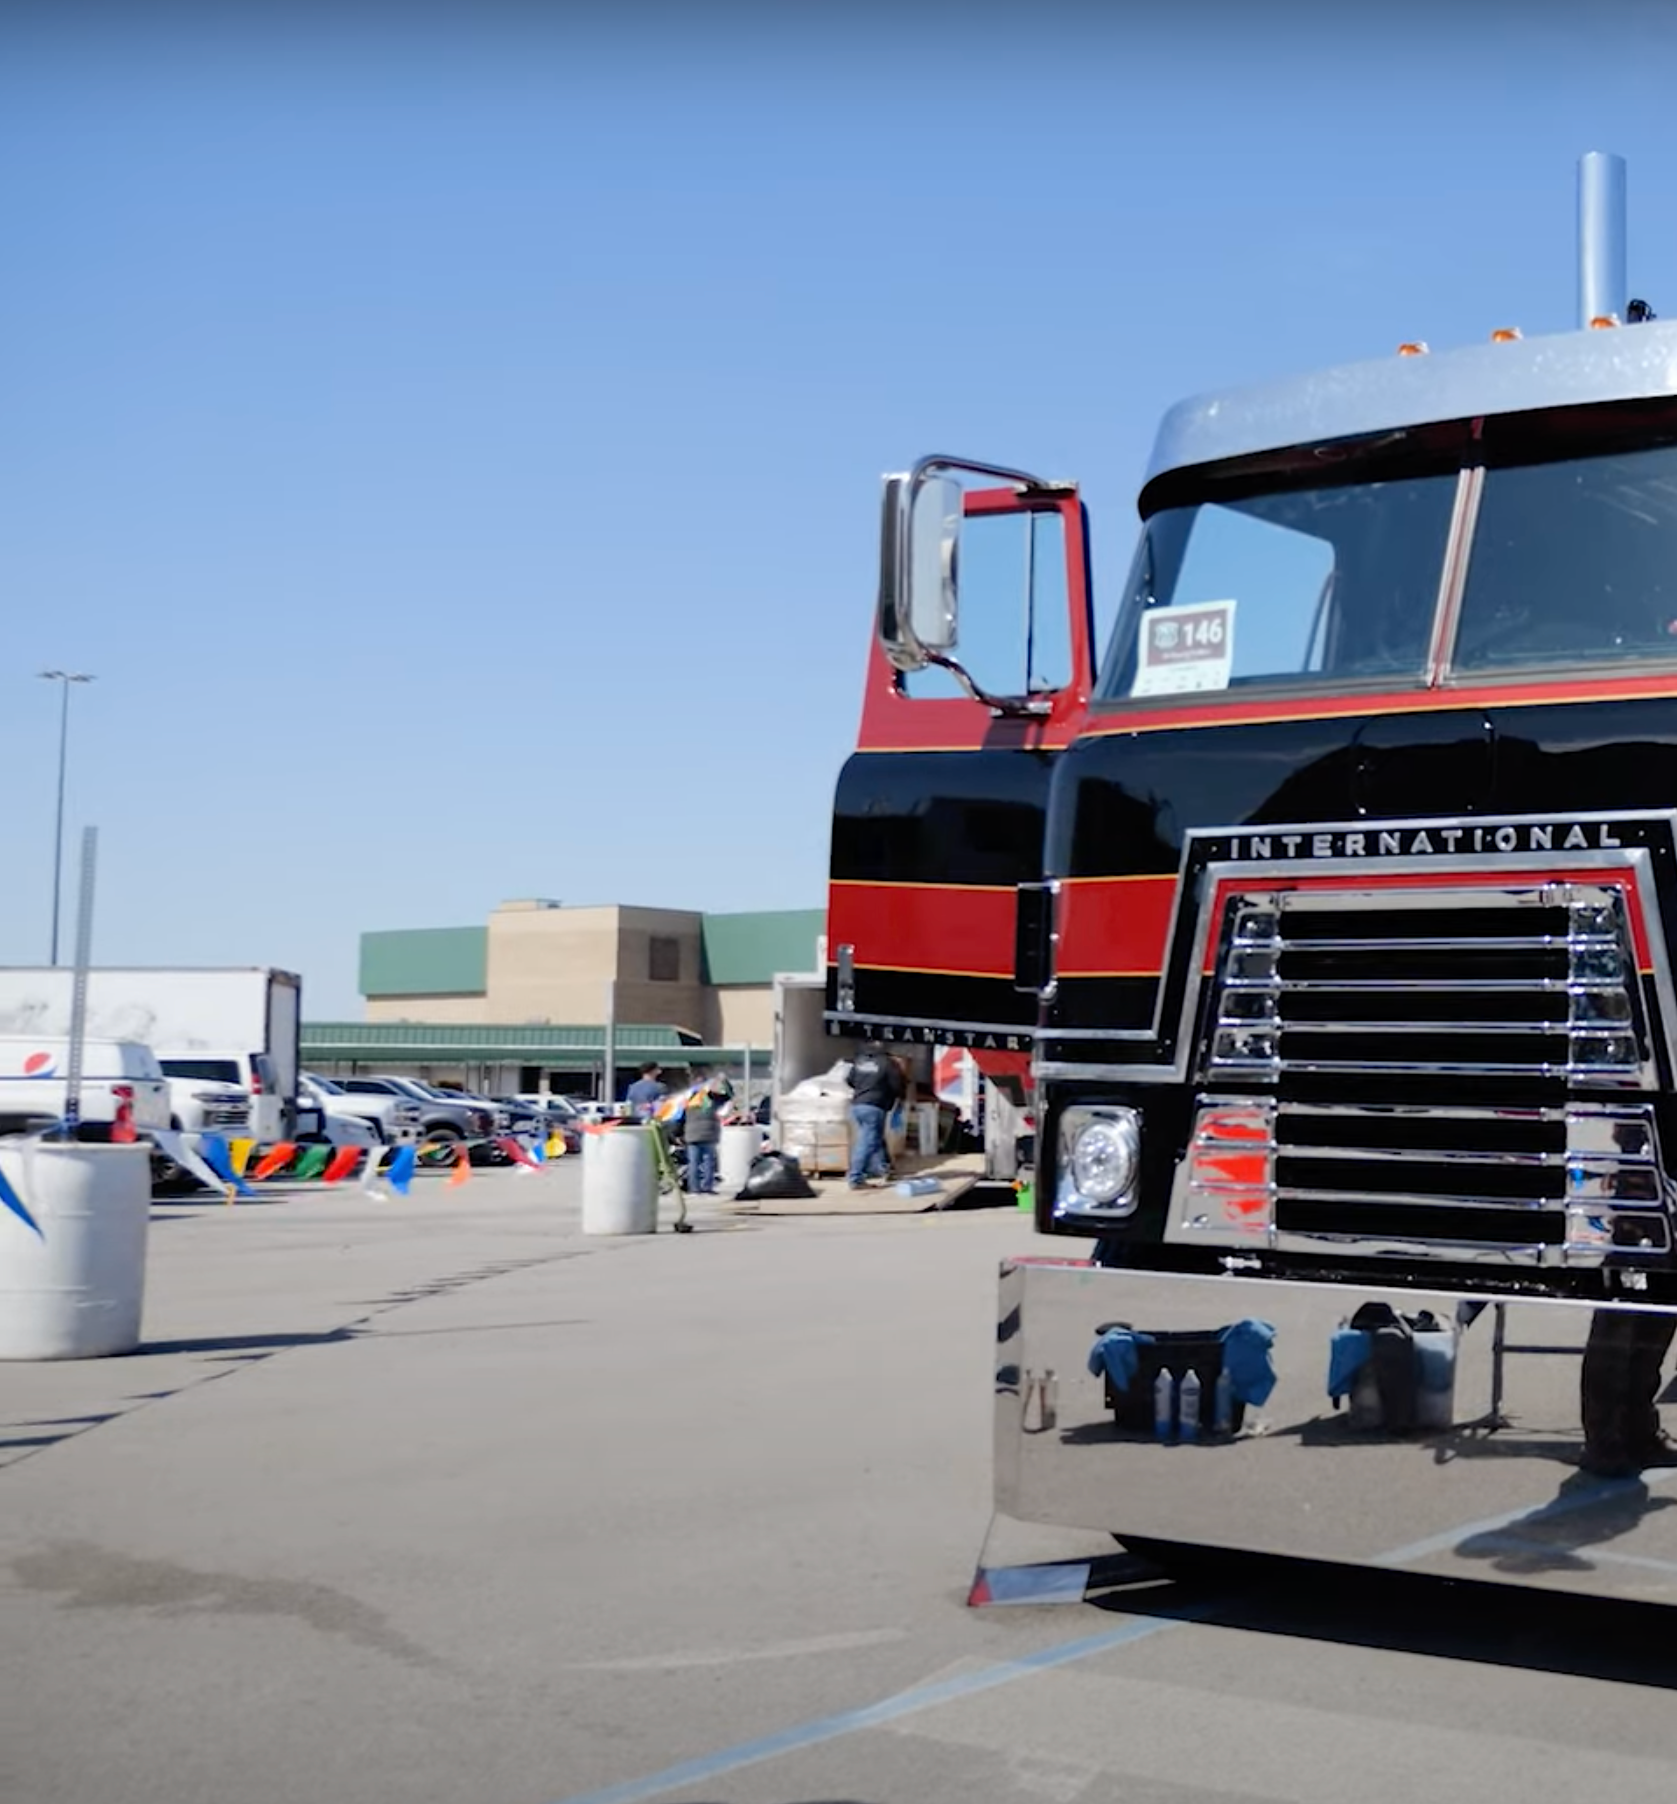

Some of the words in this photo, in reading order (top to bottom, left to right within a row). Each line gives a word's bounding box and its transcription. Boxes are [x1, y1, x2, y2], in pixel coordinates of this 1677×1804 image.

[1183, 618, 1224, 647] 146
[1230, 823, 1622, 860] INTERNATIONAL
[863, 1024, 1020, 1051] TRANSTAR
